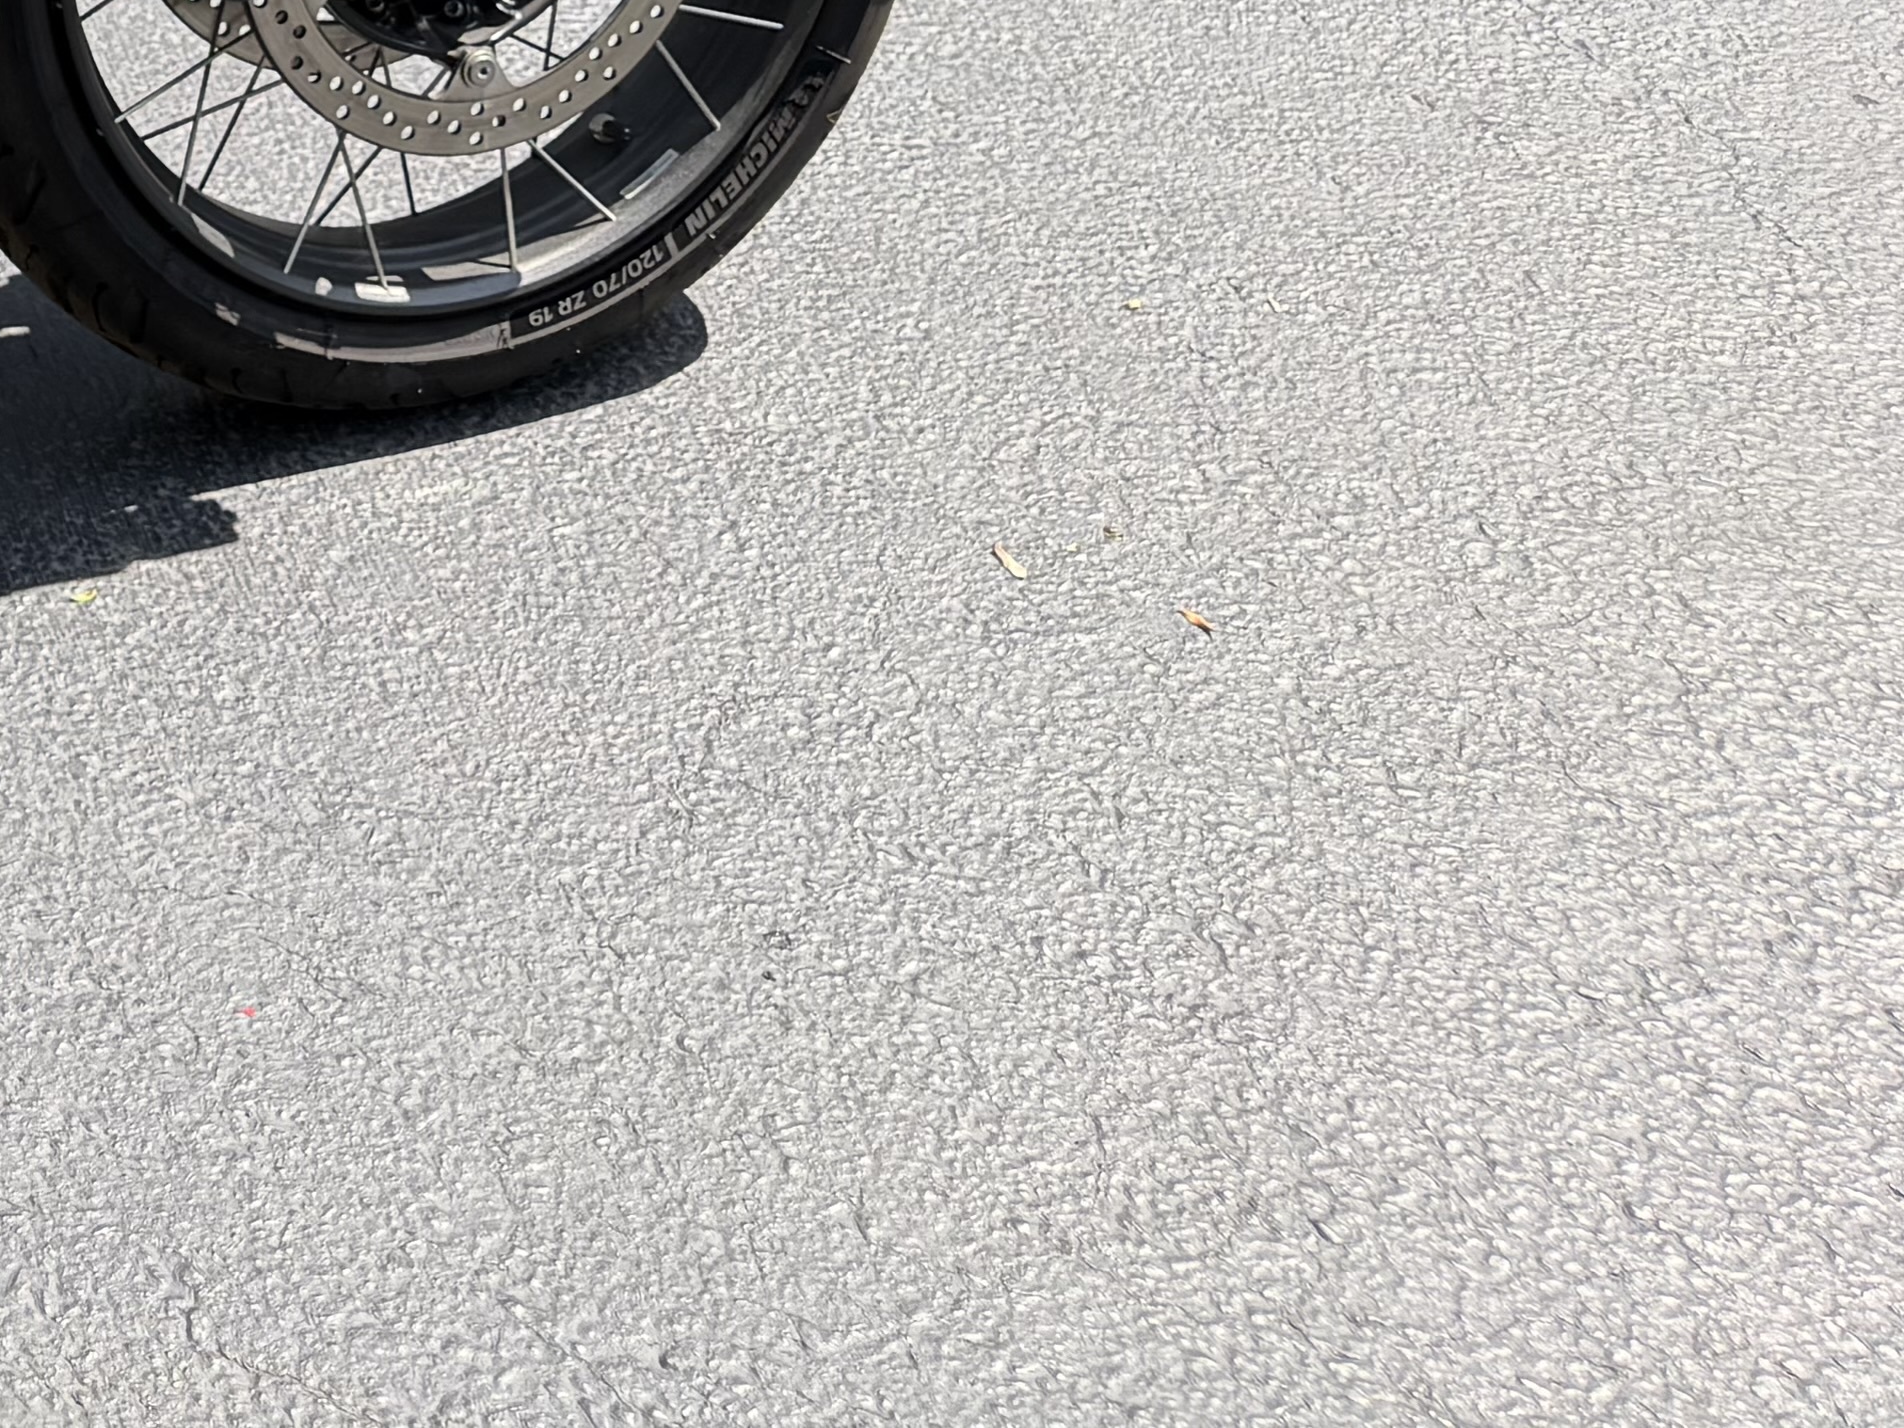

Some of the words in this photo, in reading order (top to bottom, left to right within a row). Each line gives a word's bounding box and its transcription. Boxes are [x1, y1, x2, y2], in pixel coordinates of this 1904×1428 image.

[683, 109, 796, 236] MICHELIN
[594, 242, 664, 299] 120/70
[528, 305, 553, 328] 19
[557, 292, 587, 316] ZR
